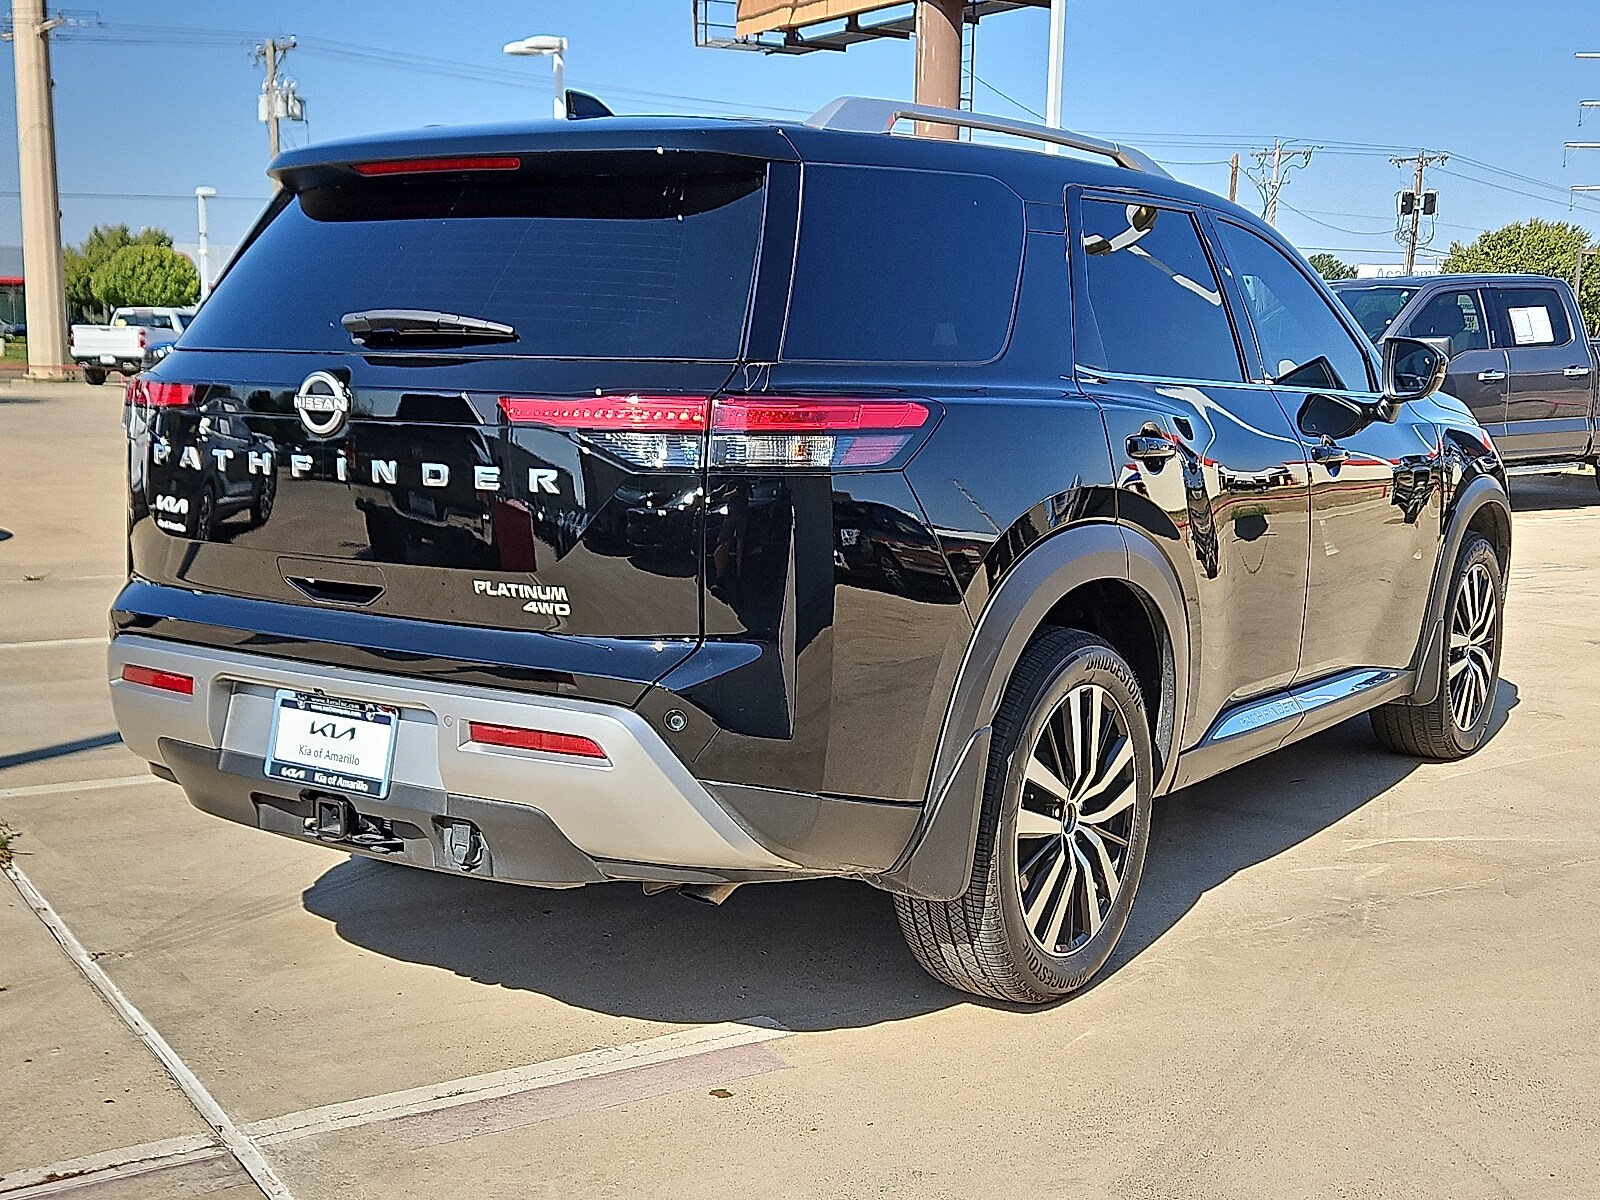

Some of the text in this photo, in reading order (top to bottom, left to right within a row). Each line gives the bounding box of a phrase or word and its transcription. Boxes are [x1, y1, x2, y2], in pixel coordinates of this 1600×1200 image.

[293, 395, 348, 411] NISSAN
[153, 442, 561, 495] PATHFINDER
[473, 580, 569, 601] PLATINUM
[522, 601, 571, 616] 4WD
[1084, 653, 1144, 714] BRIDGESTONE
[1238, 701, 1296, 727] PATHFINDER
[309, 720, 356, 741] KIA
[298, 744, 360, 766] Kia of Amarillo
[314, 772, 369, 792] Kia of Amarillo
